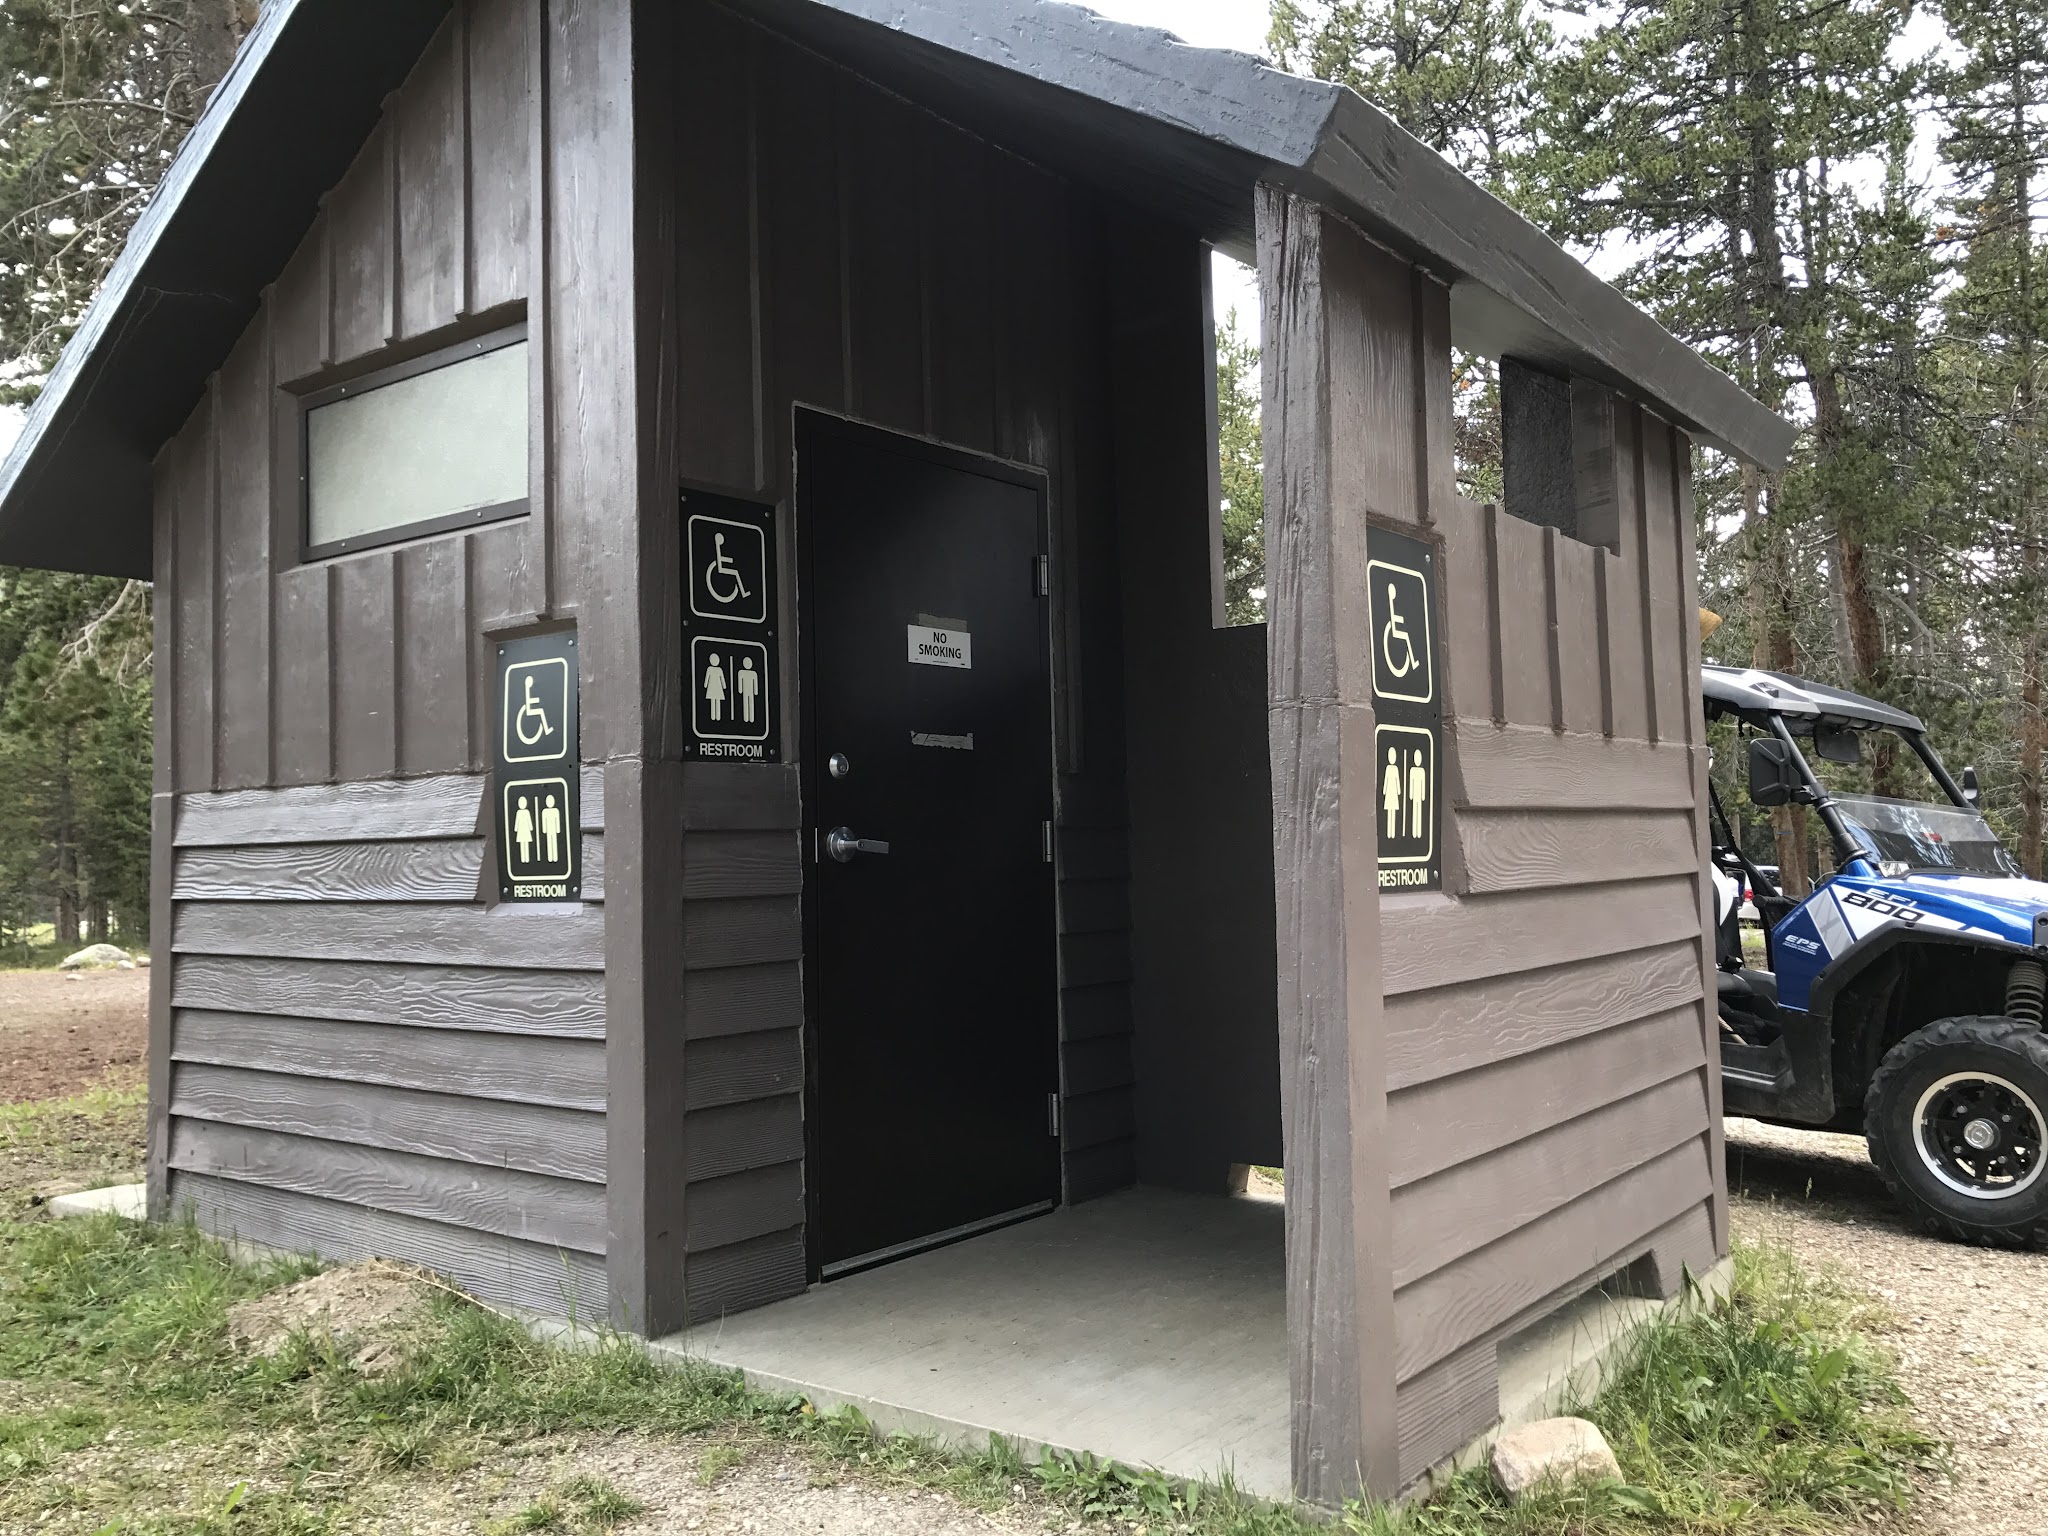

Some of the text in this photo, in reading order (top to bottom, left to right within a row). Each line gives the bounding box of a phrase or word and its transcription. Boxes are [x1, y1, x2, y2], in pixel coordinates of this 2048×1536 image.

[933, 631, 947, 644] NO
[918, 643, 962, 659] SMOKING
[699, 742, 763, 758] RESTROOM
[1377, 867, 1428, 888] RESTROOM
[513, 884, 567, 898] RESTROOM
[1865, 887, 1918, 908] EFI
[1841, 891, 1926, 923] 800
[1785, 934, 1821, 950] EPS
